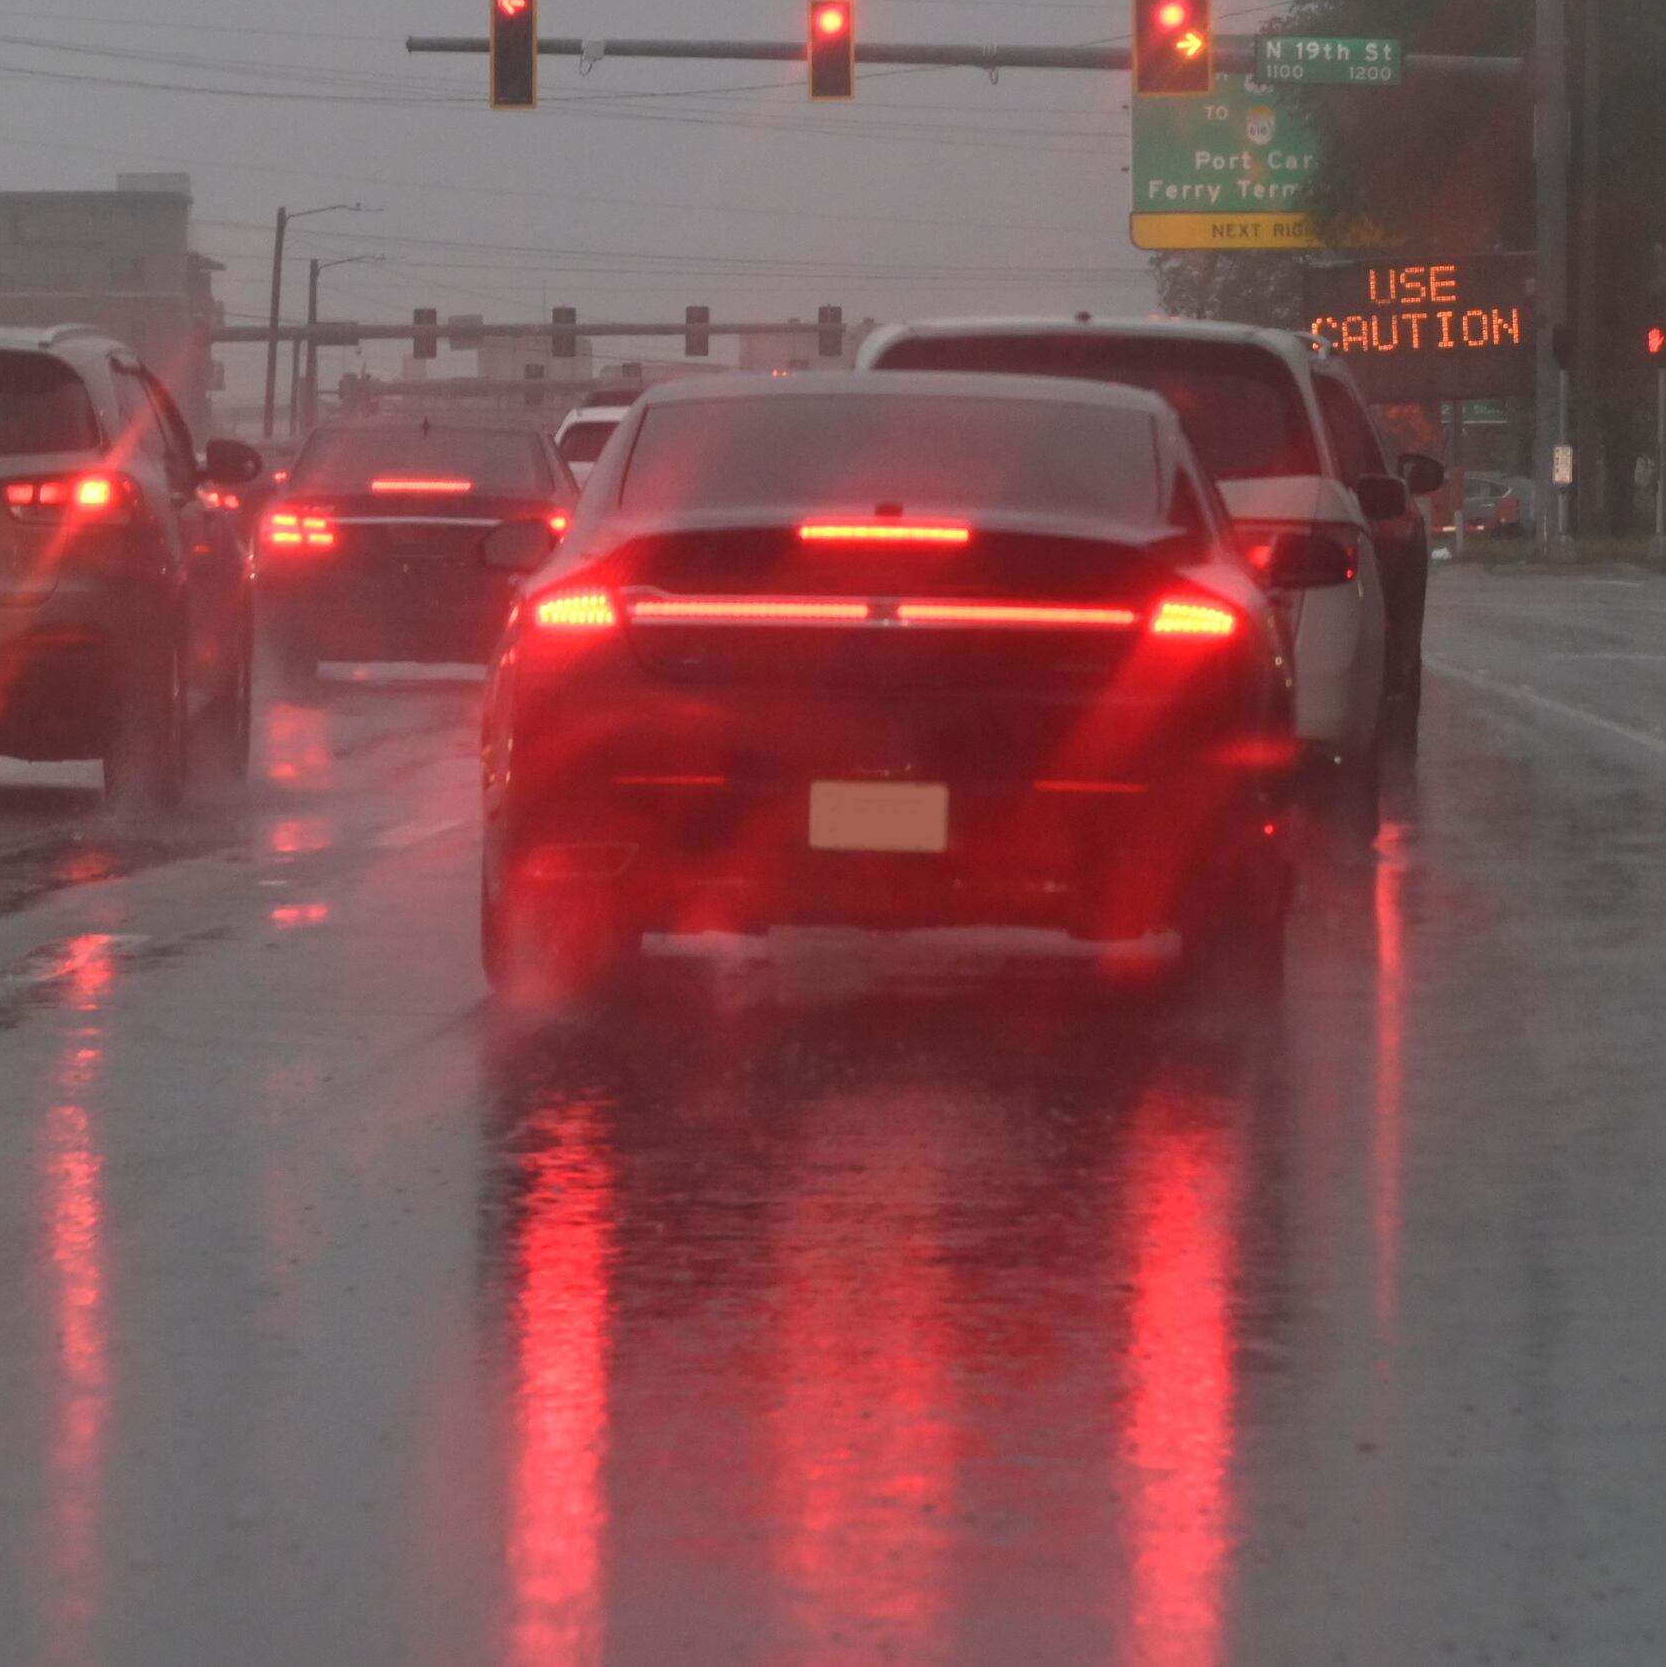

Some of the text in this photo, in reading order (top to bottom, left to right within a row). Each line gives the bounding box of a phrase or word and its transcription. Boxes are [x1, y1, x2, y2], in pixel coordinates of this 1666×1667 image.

[1266, 41, 1392, 61] N 19th St
[1266, 64, 1392, 81] 1100 1200
[1205, 106, 1229, 121] TO
[1195, 150, 1314, 170] Port Car
[1148, 179, 1221, 203] Ferry
[1212, 223, 1261, 238] NEXT
[1369, 265, 1457, 304] USE
[1310, 308, 1519, 352] CAUTION
